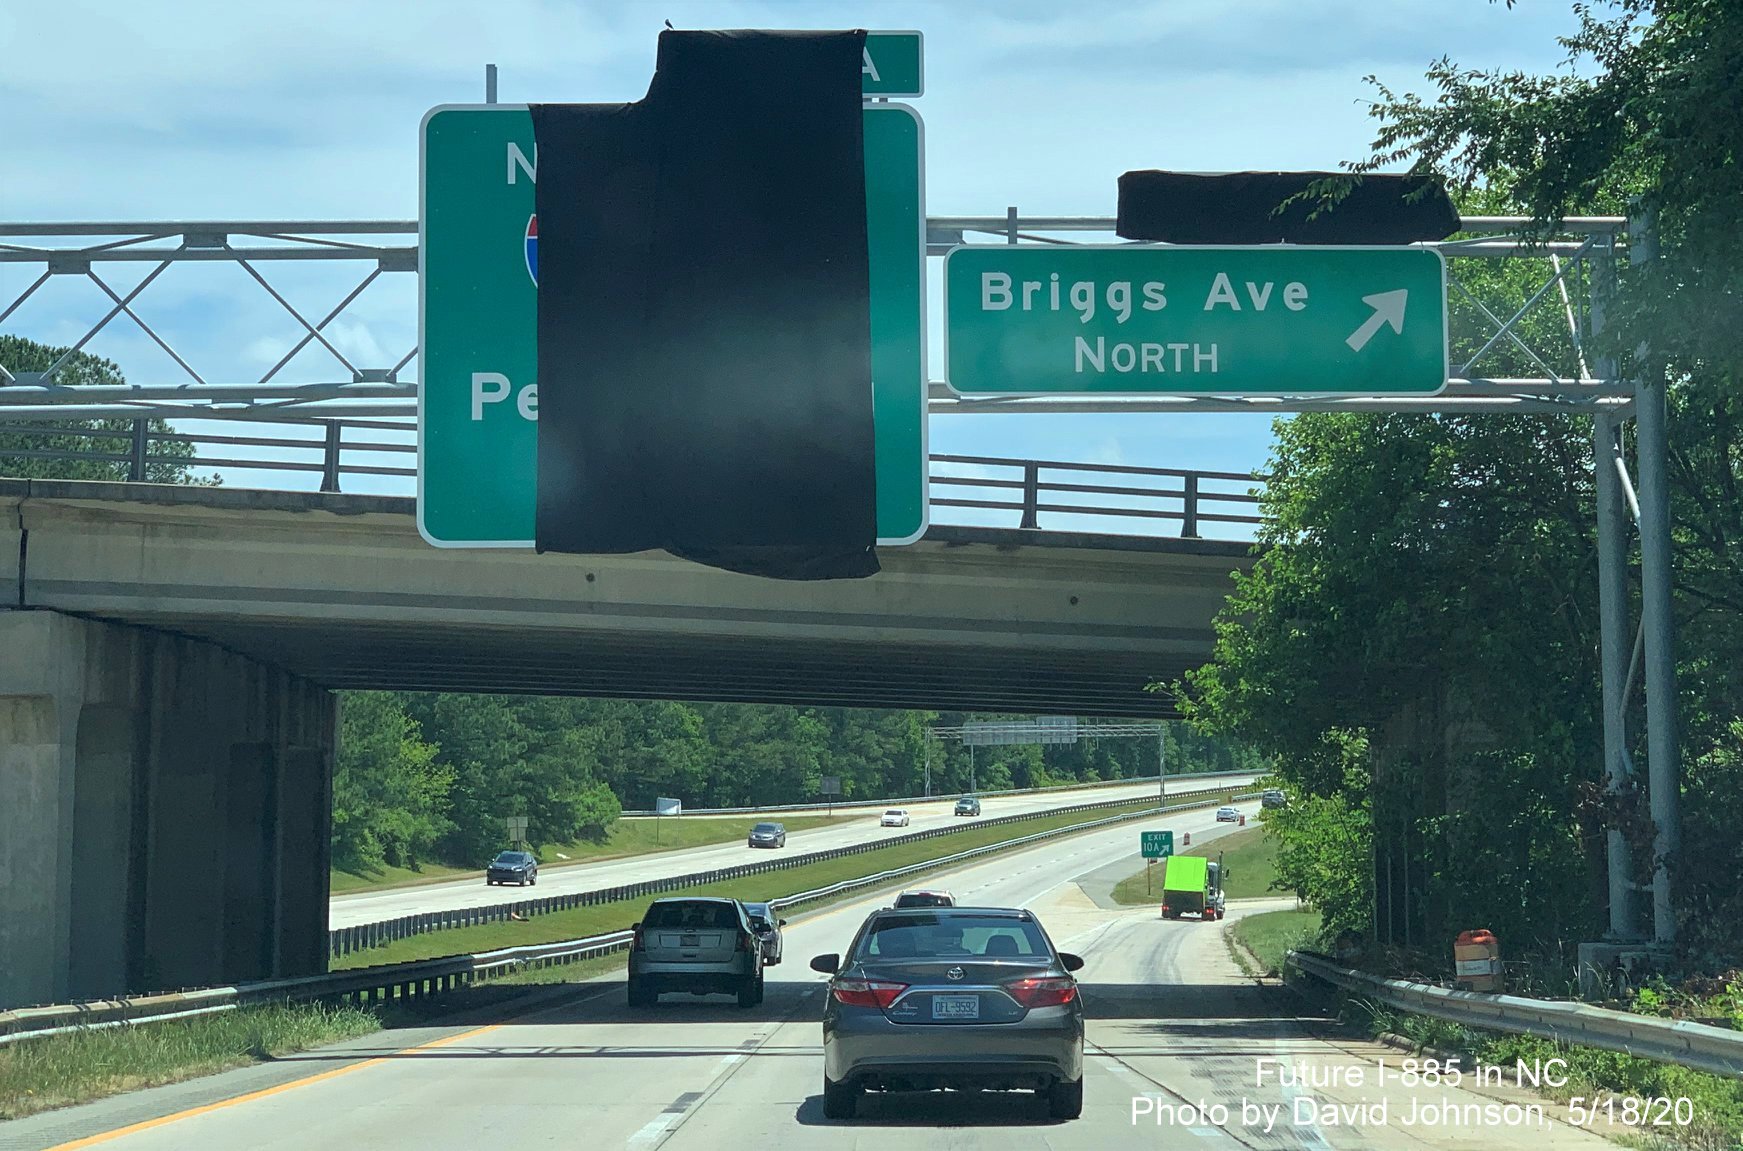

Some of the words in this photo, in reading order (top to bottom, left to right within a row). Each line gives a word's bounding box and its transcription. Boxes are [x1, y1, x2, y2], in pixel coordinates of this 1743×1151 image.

[981, 271, 1168, 324] Briggs
[1203, 272, 1309, 312] Ave
[1074, 336, 1219, 373] NORTH
[1143, 842, 1160, 852] 10A
